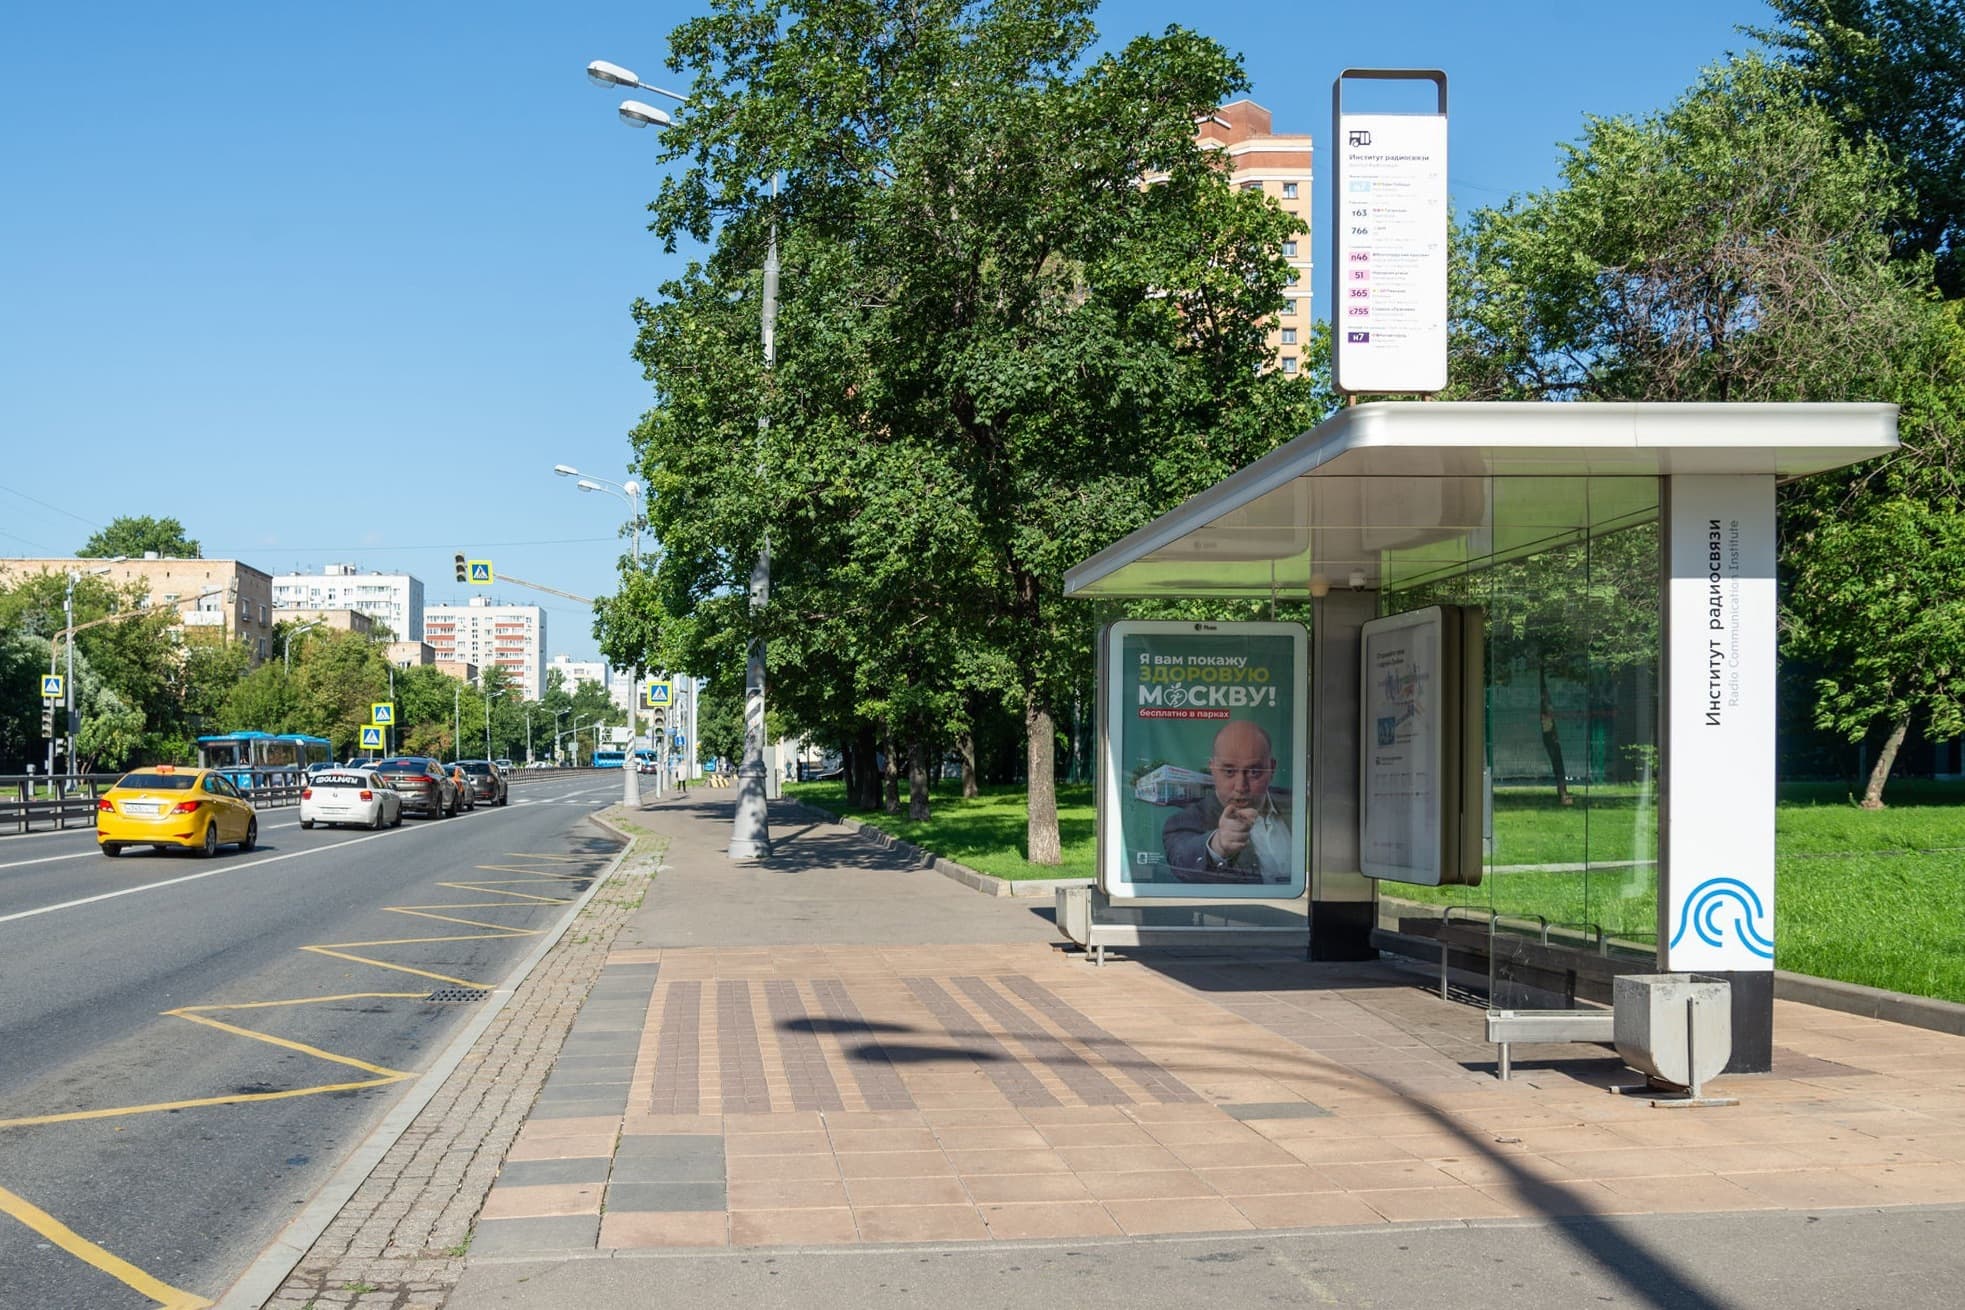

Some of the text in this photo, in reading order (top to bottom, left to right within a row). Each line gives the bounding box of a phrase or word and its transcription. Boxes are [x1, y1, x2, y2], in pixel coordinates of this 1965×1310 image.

[1355, 271, 1364, 279] 51
[1351, 289, 1367, 297] 365
[1728, 519, 1739, 706] Radio Communication Institute
[1706, 519, 1724, 725] Институт радиосвязи
[1140, 653, 1247, 668] Я вам покажу
[1139, 666, 1269, 683] ЗДОРОВУЮ
[1139, 709, 1187, 718] бесплатно
[1197, 711, 1229, 719] парках
